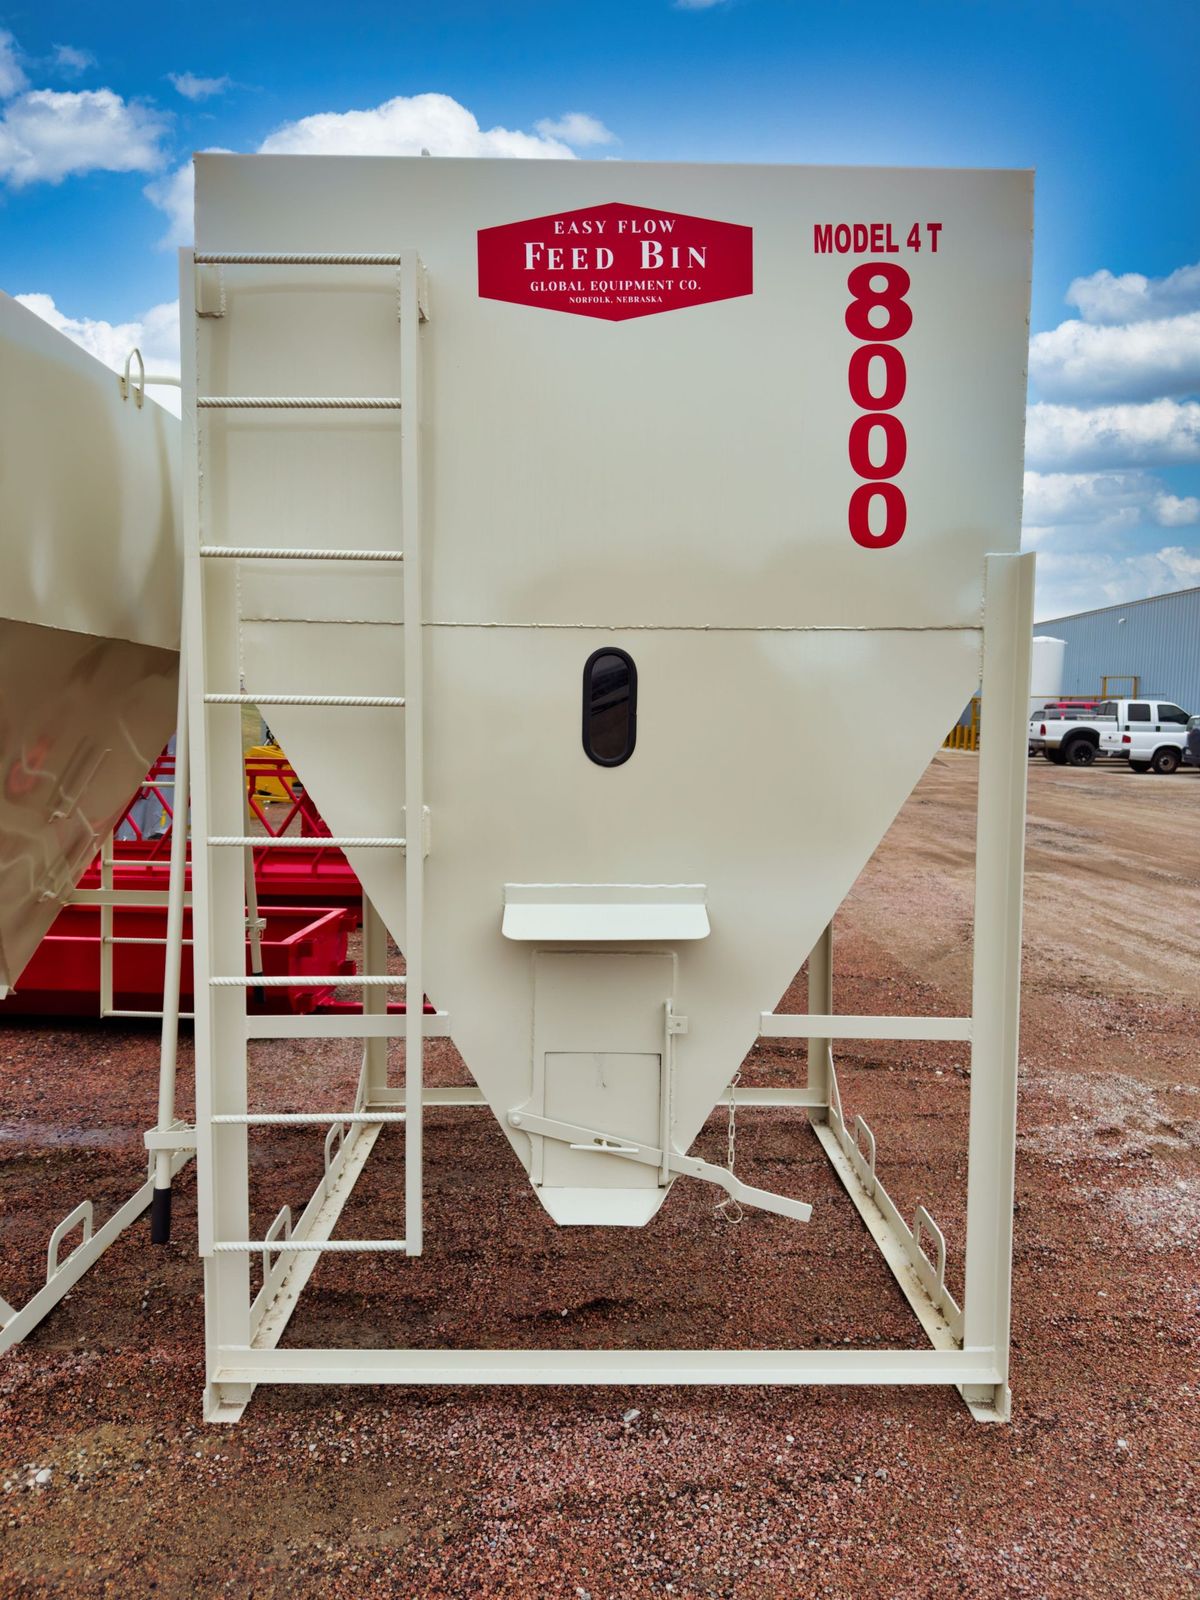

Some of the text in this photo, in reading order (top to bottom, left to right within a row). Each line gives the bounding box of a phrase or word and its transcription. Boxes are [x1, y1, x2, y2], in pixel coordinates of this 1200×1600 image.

[554, 219, 676, 235] EASY FLOW
[813, 223, 899, 254] MODEL
[523, 240, 707, 271] FEED BIN
[530, 279, 702, 293] GLOBAL EQUIPMENT CO.
[569, 295, 663, 304] NORFOLK, NEBRASKA
[844, 261, 913, 550] 8000
